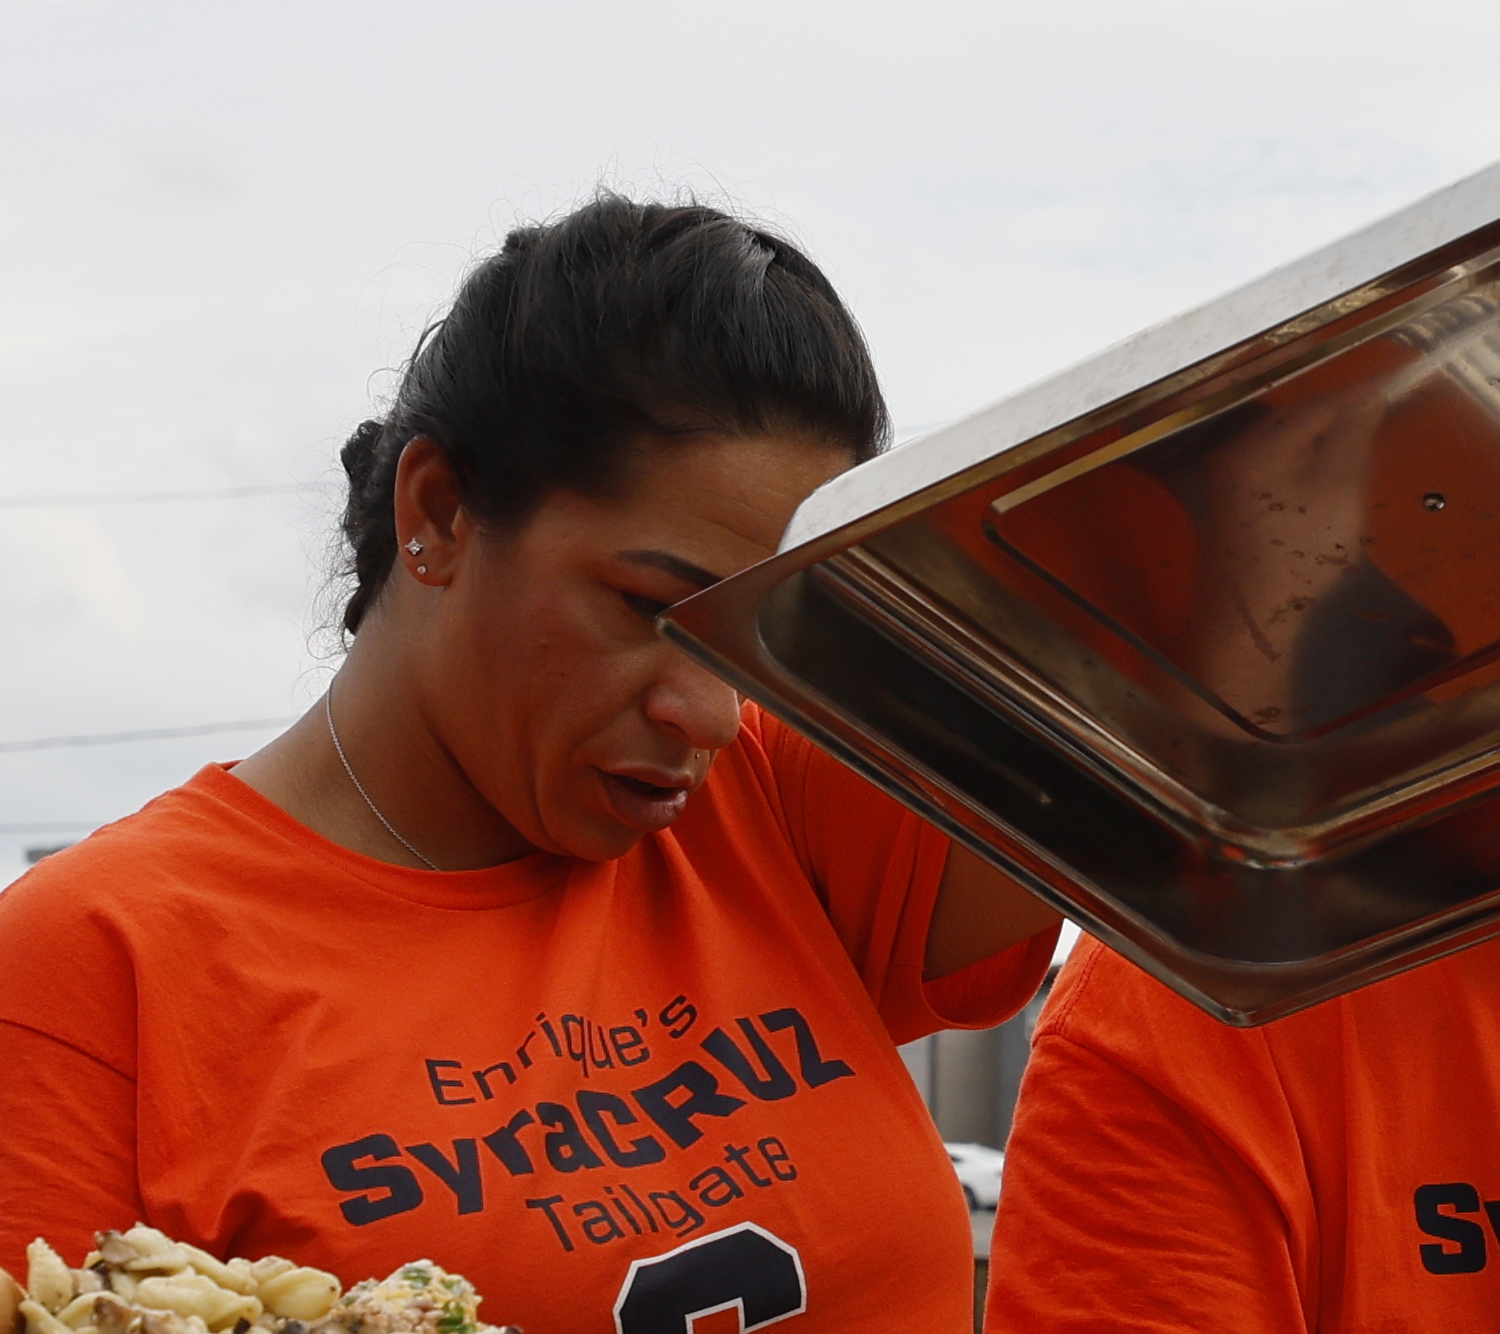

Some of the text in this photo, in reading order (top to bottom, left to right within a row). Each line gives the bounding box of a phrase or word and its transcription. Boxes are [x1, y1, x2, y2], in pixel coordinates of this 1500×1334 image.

[424, 993, 698, 1107] Enrique's
[320, 1007, 857, 1227] SyraCRUZ
[525, 1135, 799, 1253] Tailgate
